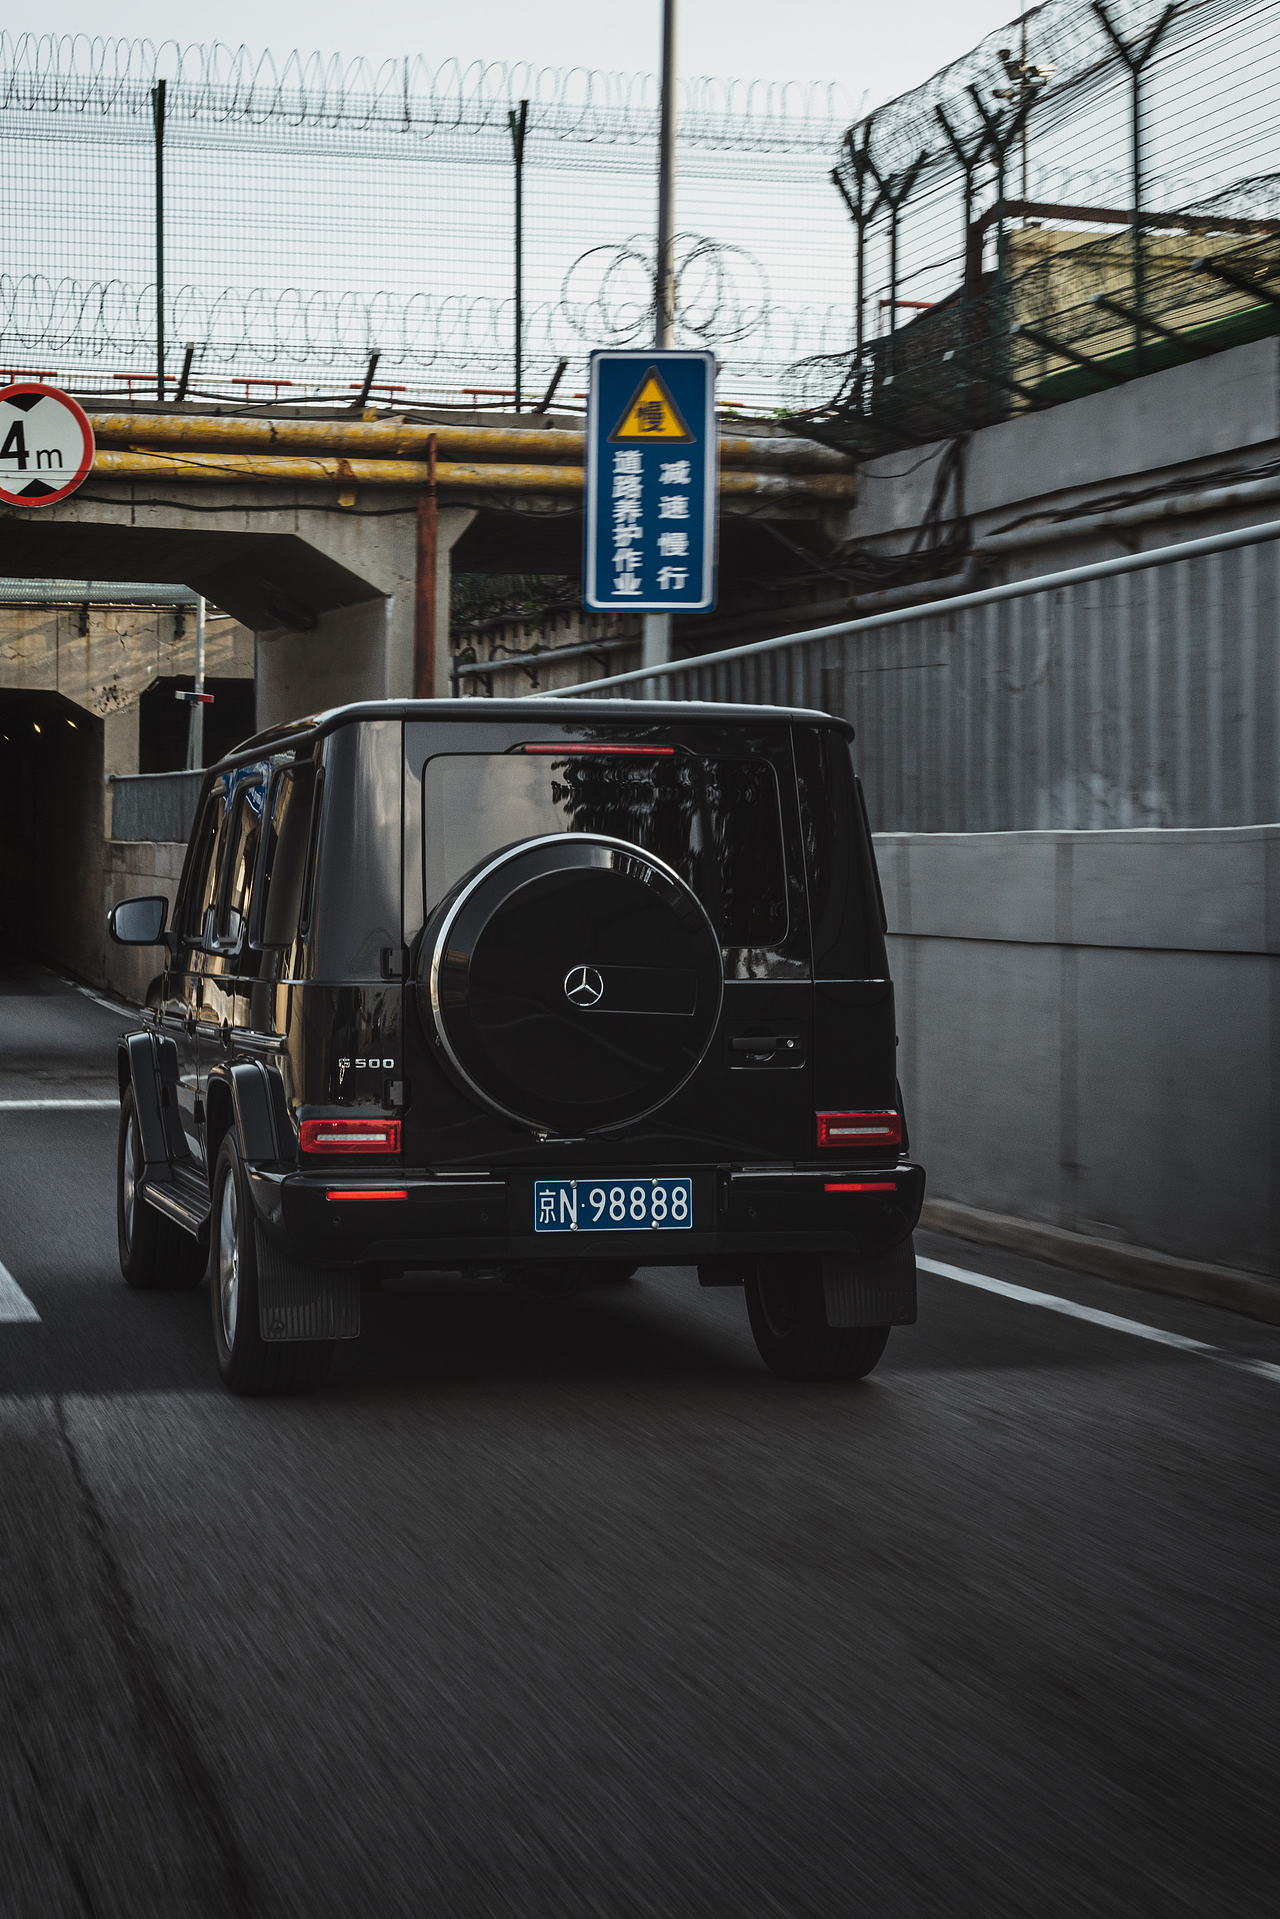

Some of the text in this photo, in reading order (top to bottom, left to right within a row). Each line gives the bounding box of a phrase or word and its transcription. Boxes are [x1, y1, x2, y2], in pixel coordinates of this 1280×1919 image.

[636, 400, 666, 433] 慢
[611, 450, 645, 596] 道路养护作业
[656, 459, 692, 590] 减速慢行
